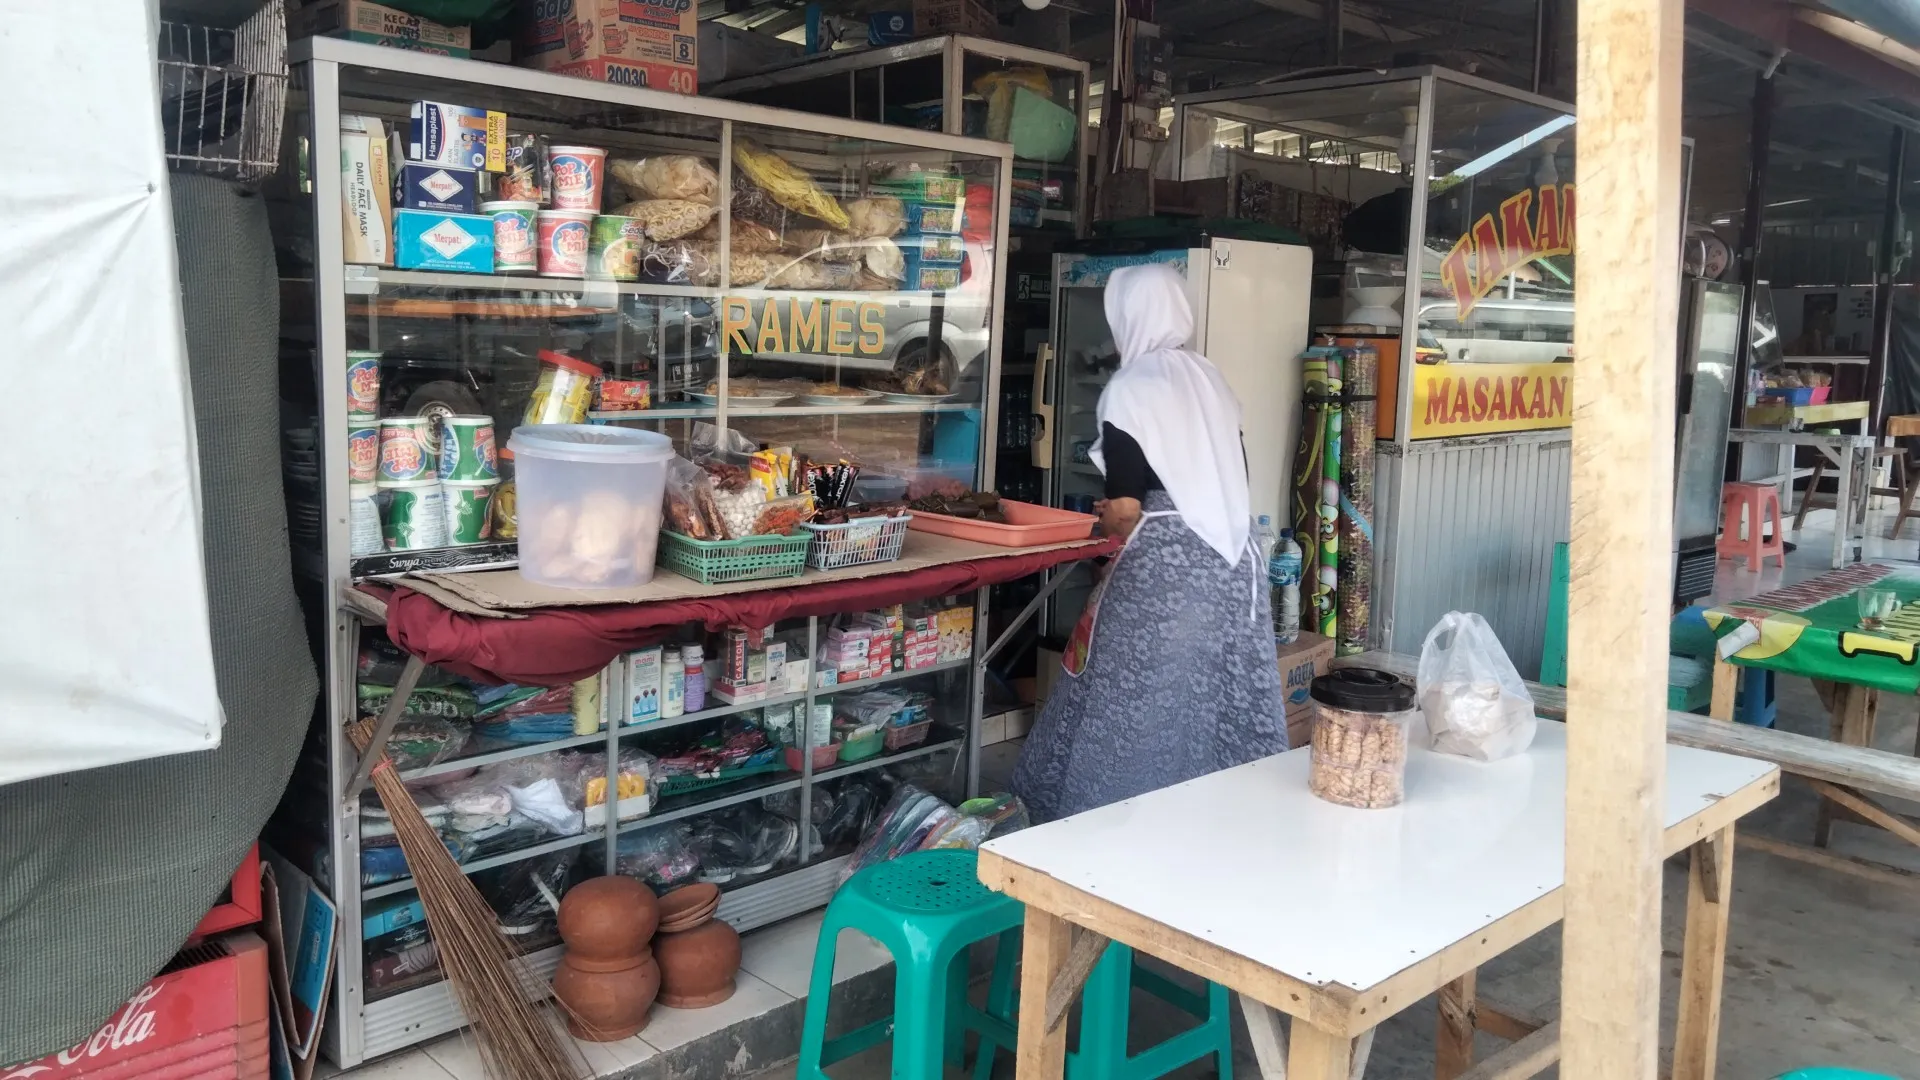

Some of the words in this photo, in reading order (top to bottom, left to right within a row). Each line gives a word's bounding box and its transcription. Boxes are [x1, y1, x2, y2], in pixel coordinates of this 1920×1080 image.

[679, 43, 690, 59] 8
[607, 65, 647, 87] 20030
[668, 70, 693, 93] 40
[428, 107, 438, 157] Hansaplast
[491, 148, 501, 161] 10
[356, 161, 364, 186] DAILY
[553, 162, 577, 177] POP
[430, 181, 453, 191] Merpati
[558, 173, 583, 187] MIE
[357, 188, 366, 209] FACE
[359, 211, 368, 238] MASK
[494, 218, 519, 234] POP
[434, 233, 462, 246] Merpati
[560, 228, 585, 242] POP
[720, 296, 886, 356] RAMES
[353, 366, 378, 381] POP
[1424, 376, 1568, 425] MASAKAN
[351, 435, 376, 453] POP
[390, 456, 419, 473] POP
[389, 557, 421, 571] Surya
[1286, 661, 1316, 689] AQUA
